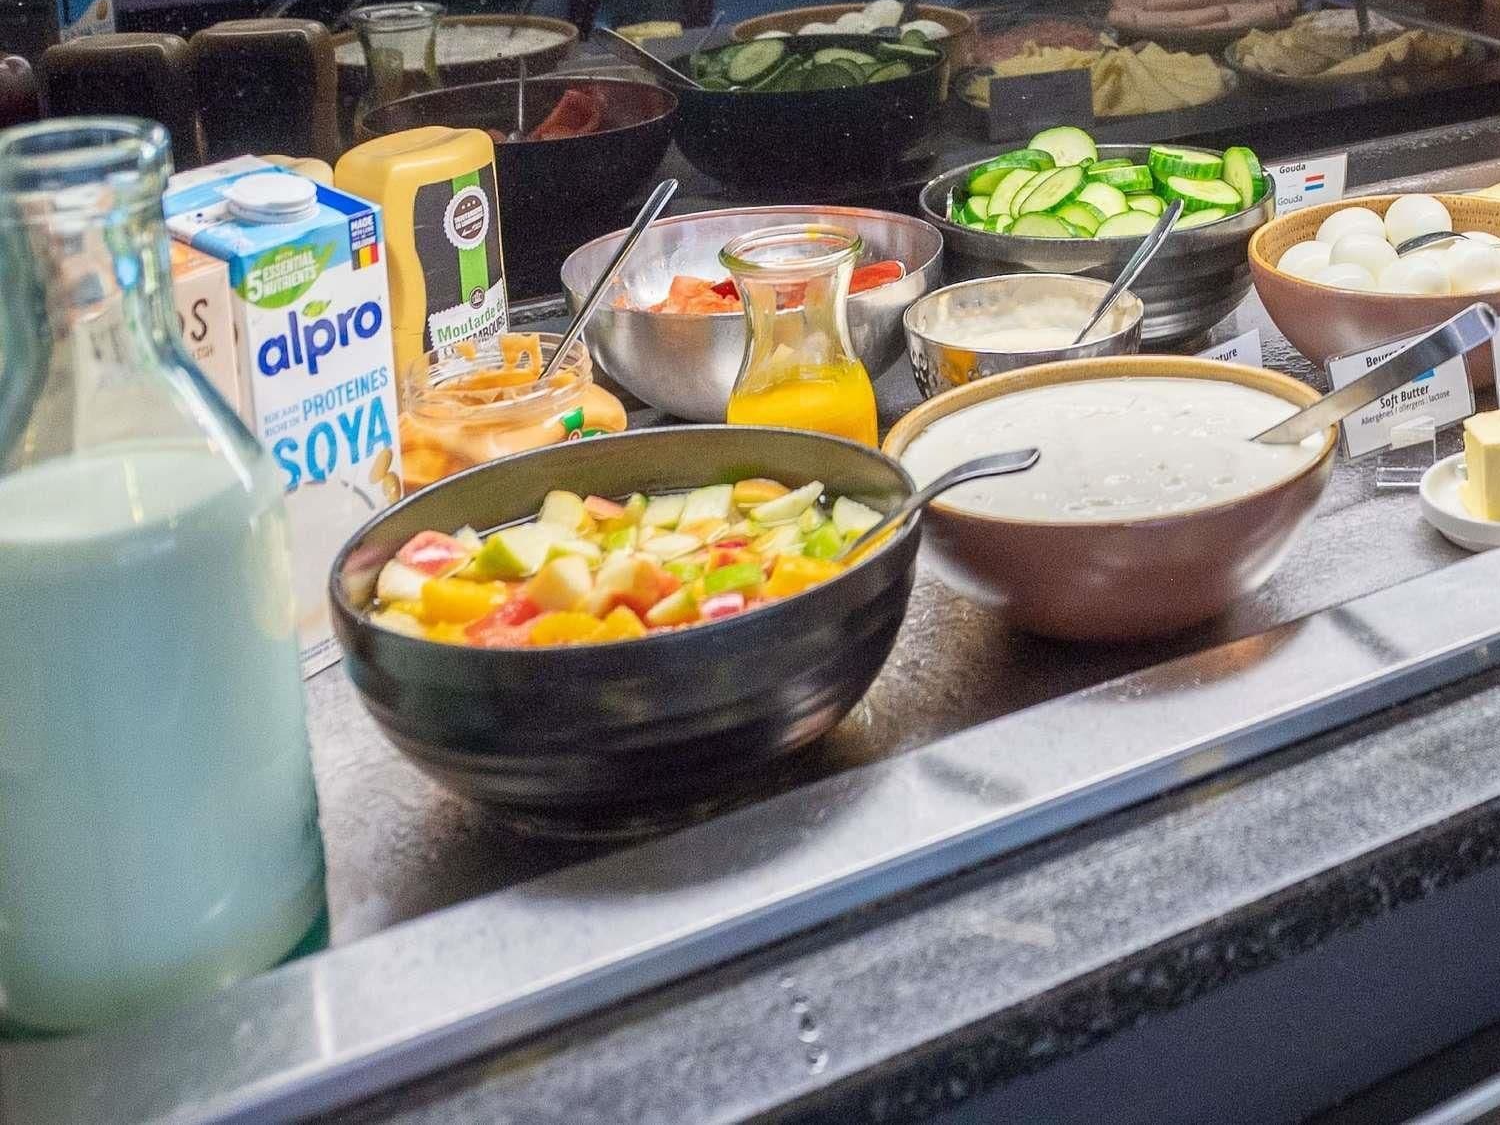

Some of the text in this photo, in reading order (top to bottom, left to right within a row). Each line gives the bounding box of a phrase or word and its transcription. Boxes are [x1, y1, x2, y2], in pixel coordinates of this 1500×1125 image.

[1279, 162, 1306, 174] Gouda
[1277, 194, 1303, 206] Gouda
[246, 251, 317, 301] 5 ESSENTIAL
[257, 300, 383, 377] alpro
[437, 307, 496, 343] Moutarde
[302, 366, 389, 421] PROTEINES
[1380, 384, 1430, 410] Soft Butter
[271, 395, 393, 493] SOYA
